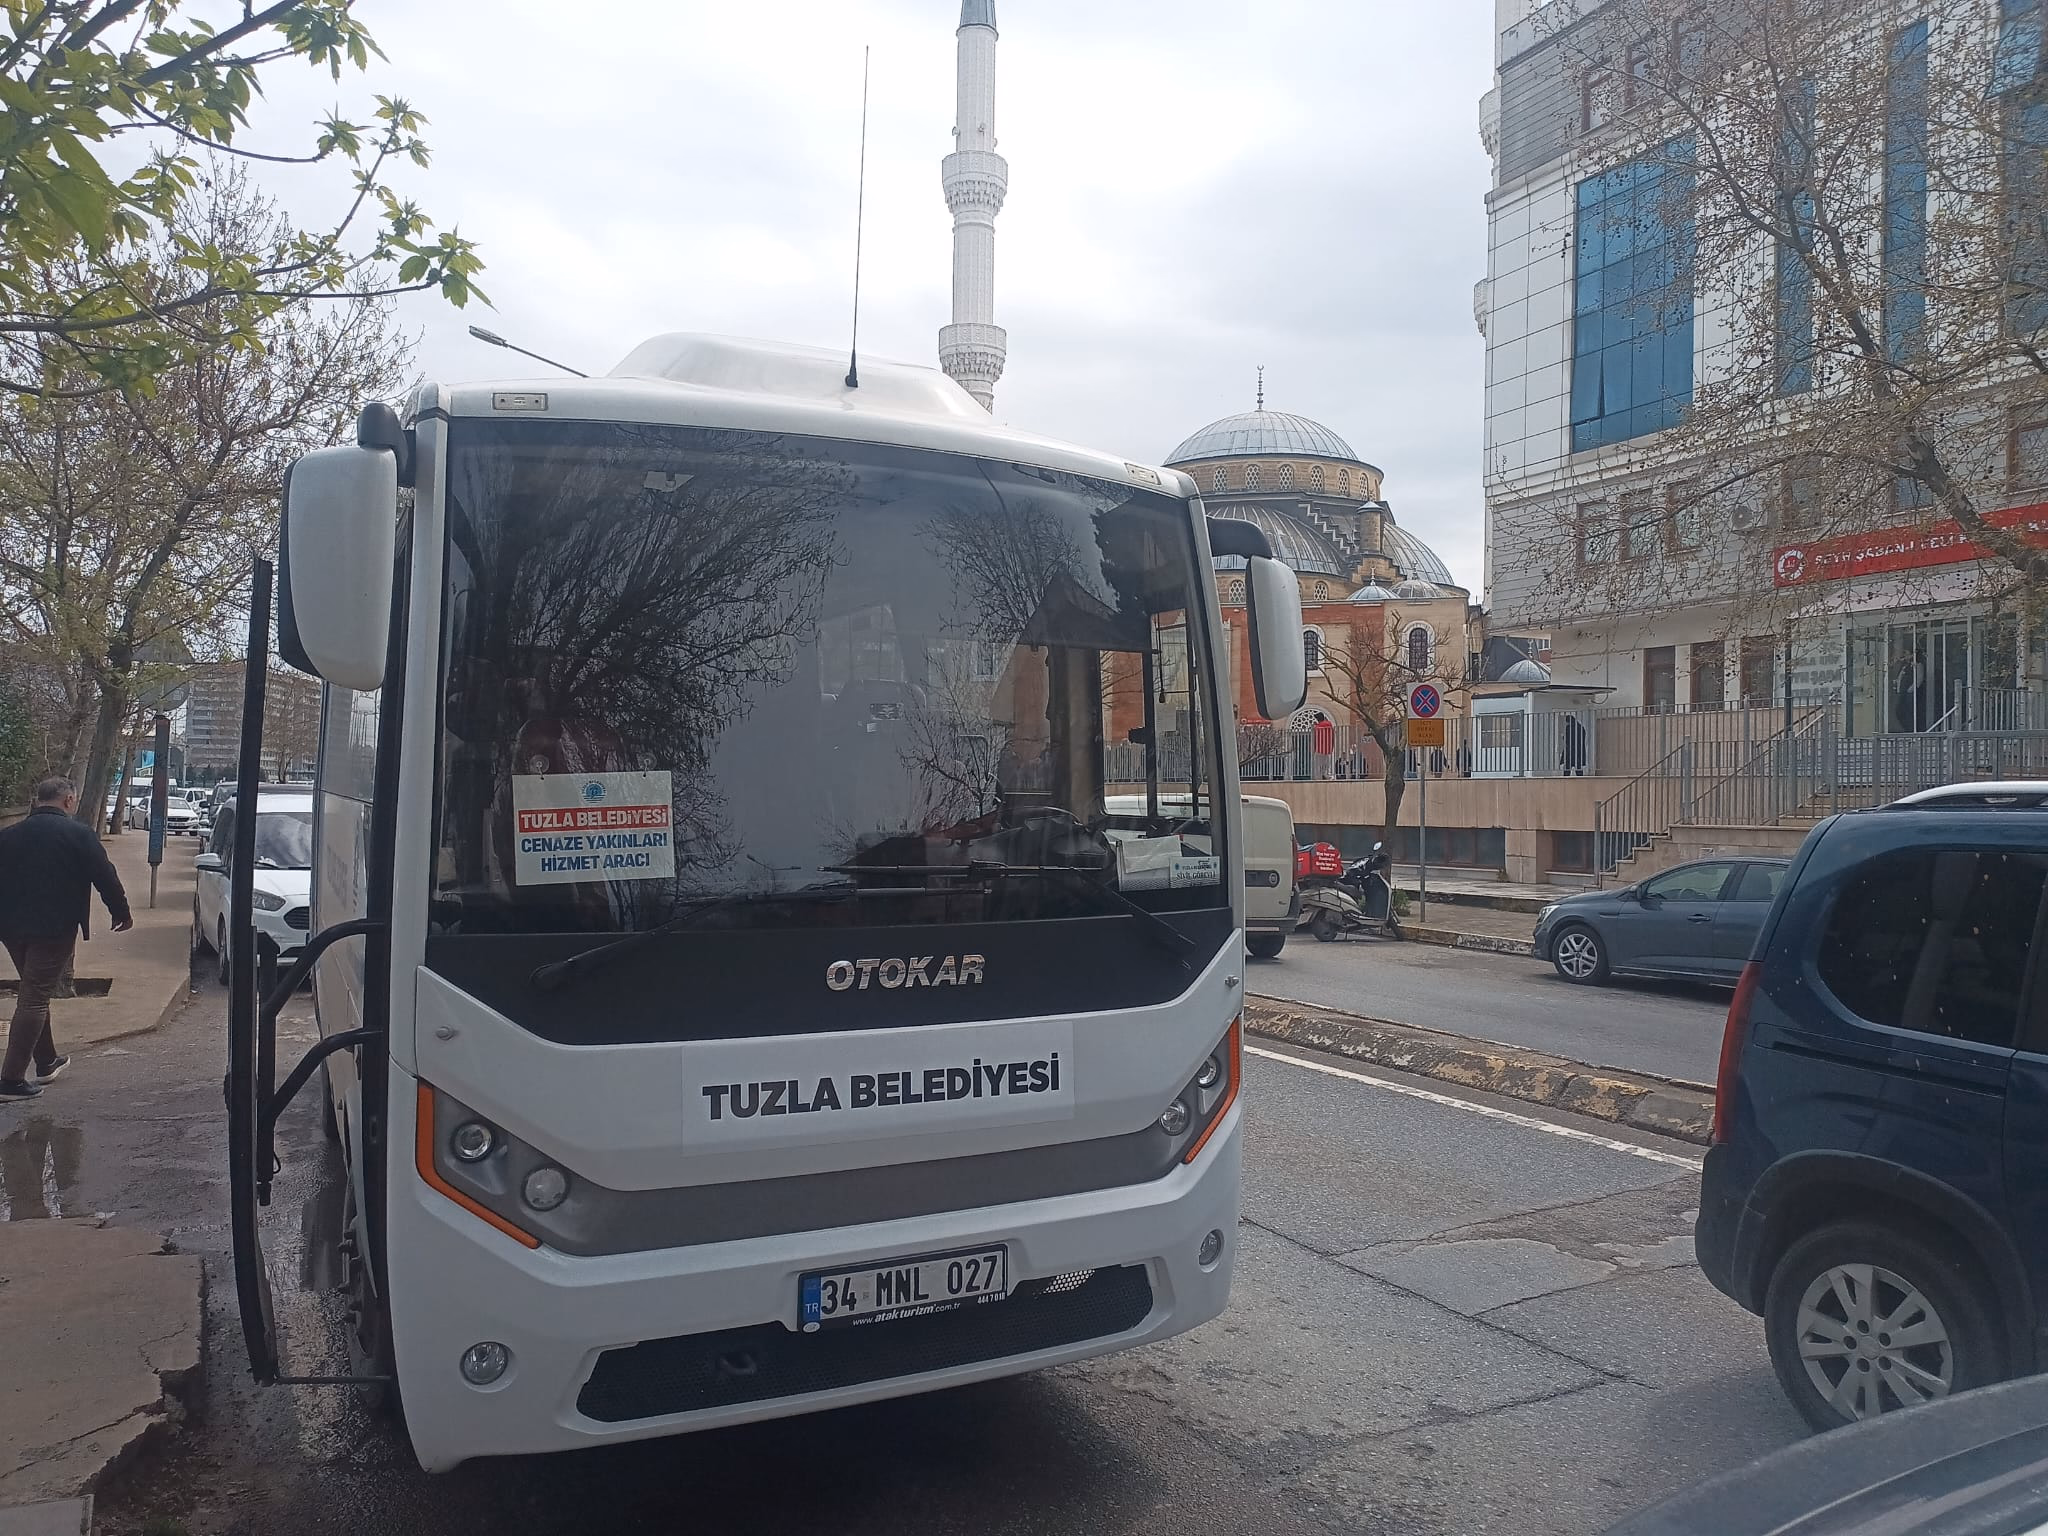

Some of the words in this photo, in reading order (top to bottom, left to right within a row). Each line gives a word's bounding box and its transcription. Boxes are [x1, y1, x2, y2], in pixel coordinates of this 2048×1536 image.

[521, 811, 574, 829] TUZLA
[577, 808, 667, 827] BELEDİYESİ
[521, 836, 583, 853] CENAZE
[586, 832, 668, 850] YAKINLARI
[541, 854, 600, 872] HİZMET
[603, 852, 650, 869] ARACI
[826, 954, 985, 991] OTOKAR
[702, 1076, 841, 1121] TUZLA
[851, 1052, 1060, 1109] BELEDİYESİ
[821, 1276, 857, 1315] 34
[876, 1266, 929, 1307] MNL
[947, 1255, 997, 1295] 027
[805, 1302, 819, 1314] TR
